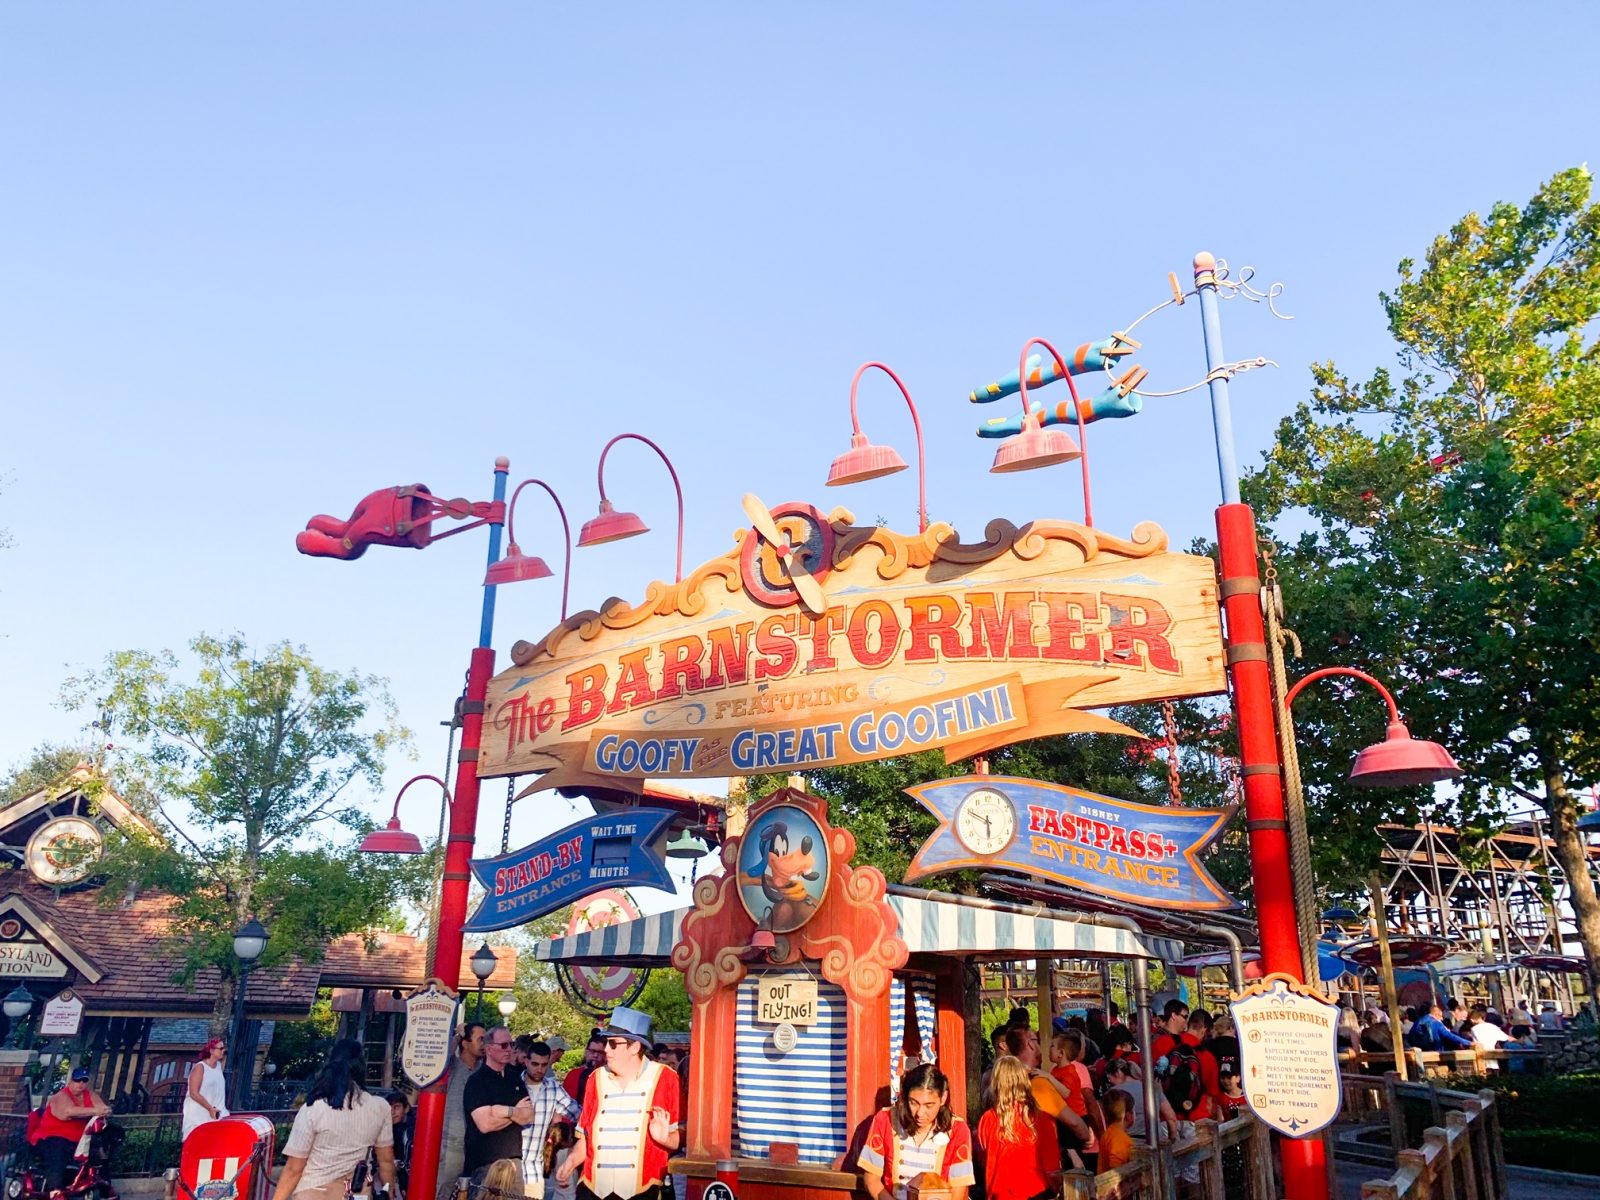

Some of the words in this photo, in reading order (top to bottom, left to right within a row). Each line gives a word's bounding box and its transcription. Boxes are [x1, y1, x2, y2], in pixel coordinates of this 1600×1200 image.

[494, 690, 555, 760] The
[561, 590, 1183, 732] BARNSTORMER
[714, 683, 858, 720] FEATURING
[596, 734, 703, 774] GOOFY
[730, 723, 844, 770] GREAT
[849, 683, 1017, 755] GOOFINI
[1080, 805, 1120, 822] DISNEY
[591, 825, 613, 838] WAIT
[616, 824, 637, 835] TIME
[1027, 804, 1178, 862] FASTPASS+
[495, 835, 583, 897] STAND-BY
[589, 866, 629, 878] MINUTES
[1029, 835, 1179, 888] ENTRANCE
[497, 869, 581, 913] ENTRANCE
[770, 984, 792, 1000] OUT
[763, 1002, 812, 1020] FLYING!
[1252, 1010, 1329, 1028] BARNSTORMER
[1269, 1099, 1286, 1107] MUST
[1288, 1100, 1318, 1108] TRANSFER
